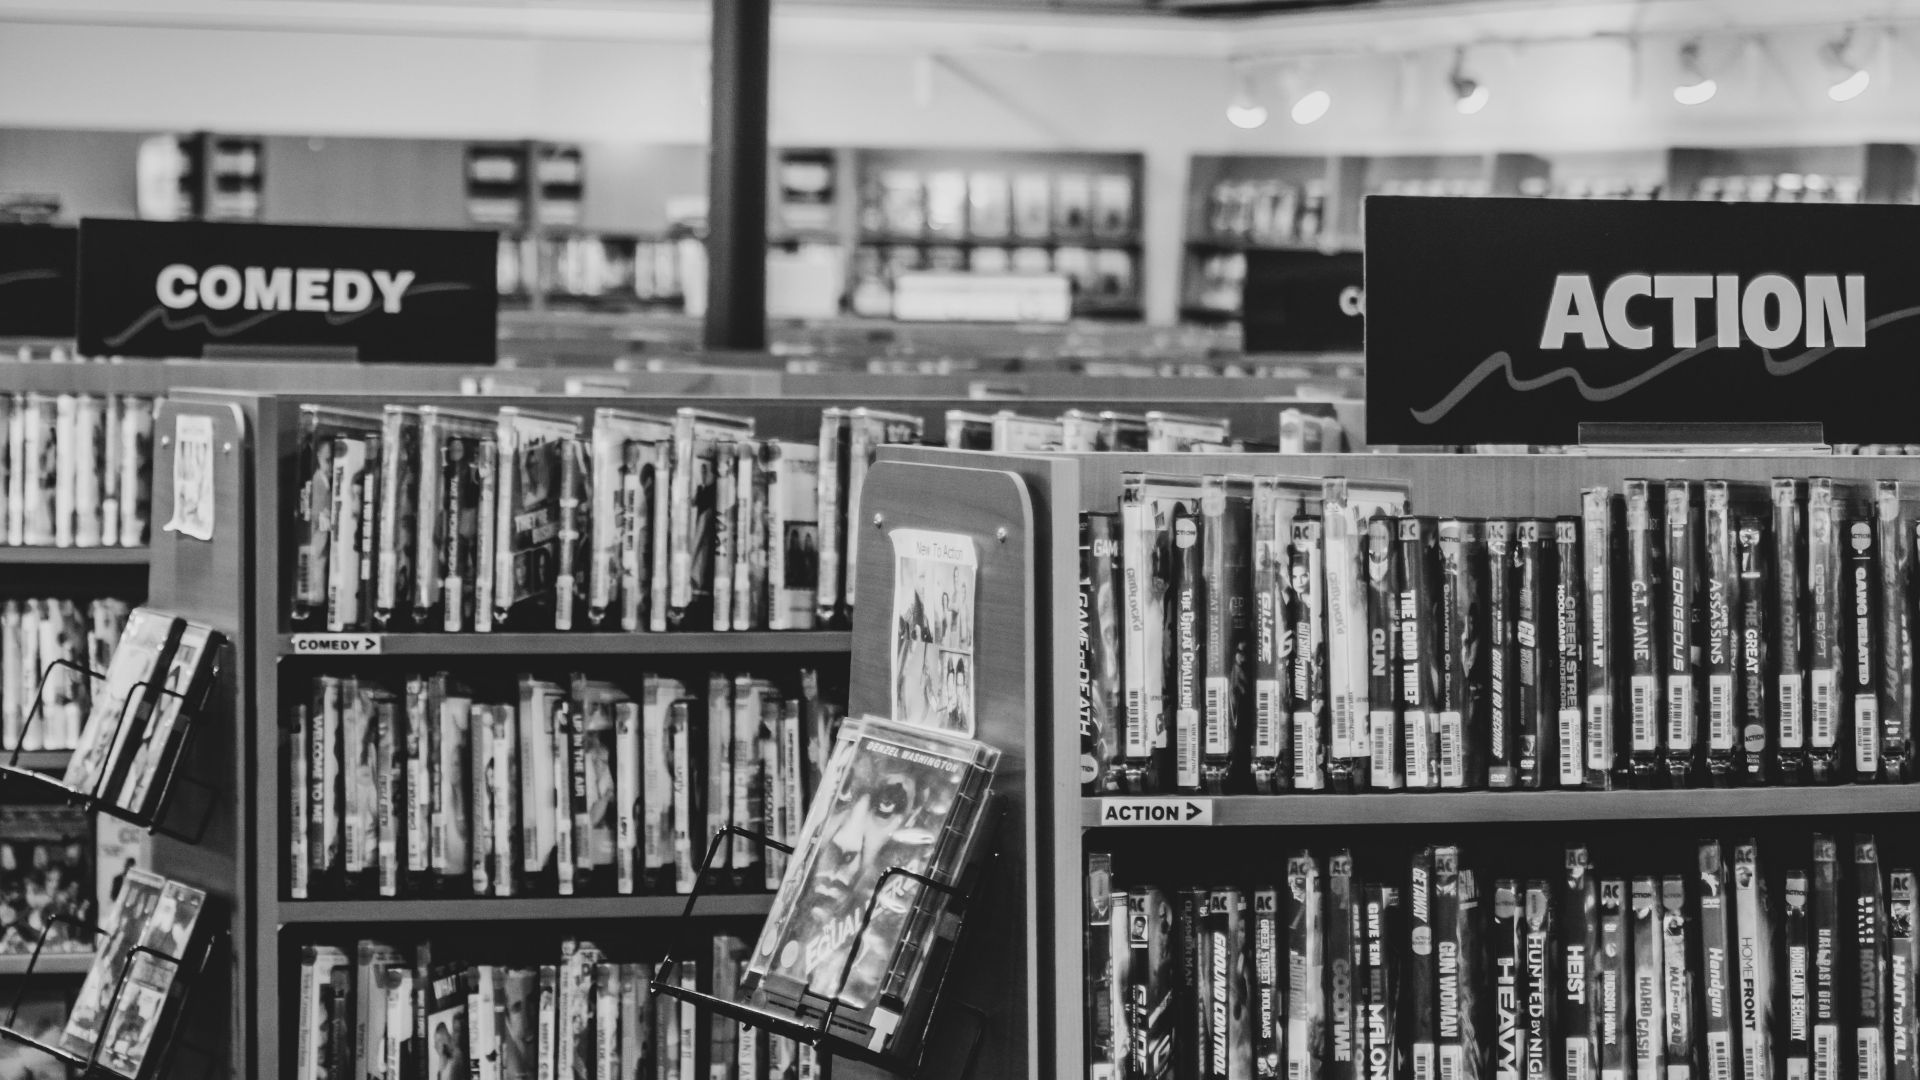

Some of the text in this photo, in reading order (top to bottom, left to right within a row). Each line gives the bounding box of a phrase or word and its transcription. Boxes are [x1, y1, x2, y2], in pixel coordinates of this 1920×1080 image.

[155, 263, 415, 313] COMEDY
[1540, 274, 1866, 350] ACTION
[1293, 525, 1309, 540] AC
[1518, 525, 1535, 540] AC
[1180, 611, 1195, 650] GREAT
[1557, 584, 1566, 651] HOOLIGANS
[1565, 596, 1577, 657] GREEN
[1633, 615, 1649, 661] JANE
[1672, 566, 1684, 672] GORGEOUS
[1709, 577, 1724, 665] ASSASSINS
[1816, 611, 1827, 658] EGYPT
[1855, 567, 1870, 685] GANG RELATED
[298, 639, 360, 651] COMEDY
[1371, 628, 1386, 677] GUN
[1400, 589, 1419, 706] THE GOOD THIEF
[1745, 600, 1760, 719] THE GREAT FIGHT
[573, 733, 584, 747] IN
[866, 741, 959, 773] DENZEL WASHINGTON
[1744, 732, 1765, 743] ACTION
[573, 749, 585, 773] THE
[312, 782, 323, 801] TO
[312, 803, 323, 824] ME
[1105, 805, 1179, 821] ACTION
[1131, 898, 1145, 912] AC
[1211, 896, 1227, 911] AC
[1256, 896, 1271, 911] AC
[1412, 867, 1428, 923] GETAWAY
[1603, 884, 1619, 899] AC
[1893, 877, 1909, 891] AC
[1367, 902, 1380, 938] GIVE
[1369, 940, 1381, 966] 'EM
[1528, 934, 1543, 1016] HUNTED
[1567, 945, 1585, 1004] HEIST
[1260, 918, 1271, 1039] GREEN STREET HOOLIGANS
[1438, 941, 1458, 1037] GUN WOMAN
[1669, 966, 1680, 997] HALF
[1708, 947, 1724, 1018] Handgun
[1859, 949, 1875, 1018] HOSTAGE
[1892, 954, 1906, 1006] HUNT
[1213, 931, 1227, 1076] GROUND CONTROL
[1497, 957, 1517, 1073] HEAVY
[1604, 970, 1616, 1045] HUDSON HAWK
[1636, 976, 1653, 1060] HARD CASH
[1791, 998, 1806, 1040] SECURITY
[1818, 991, 1831, 1018] DEAD
[1530, 1019, 1541, 1037] BY
[1894, 1025, 1907, 1065] KILL
